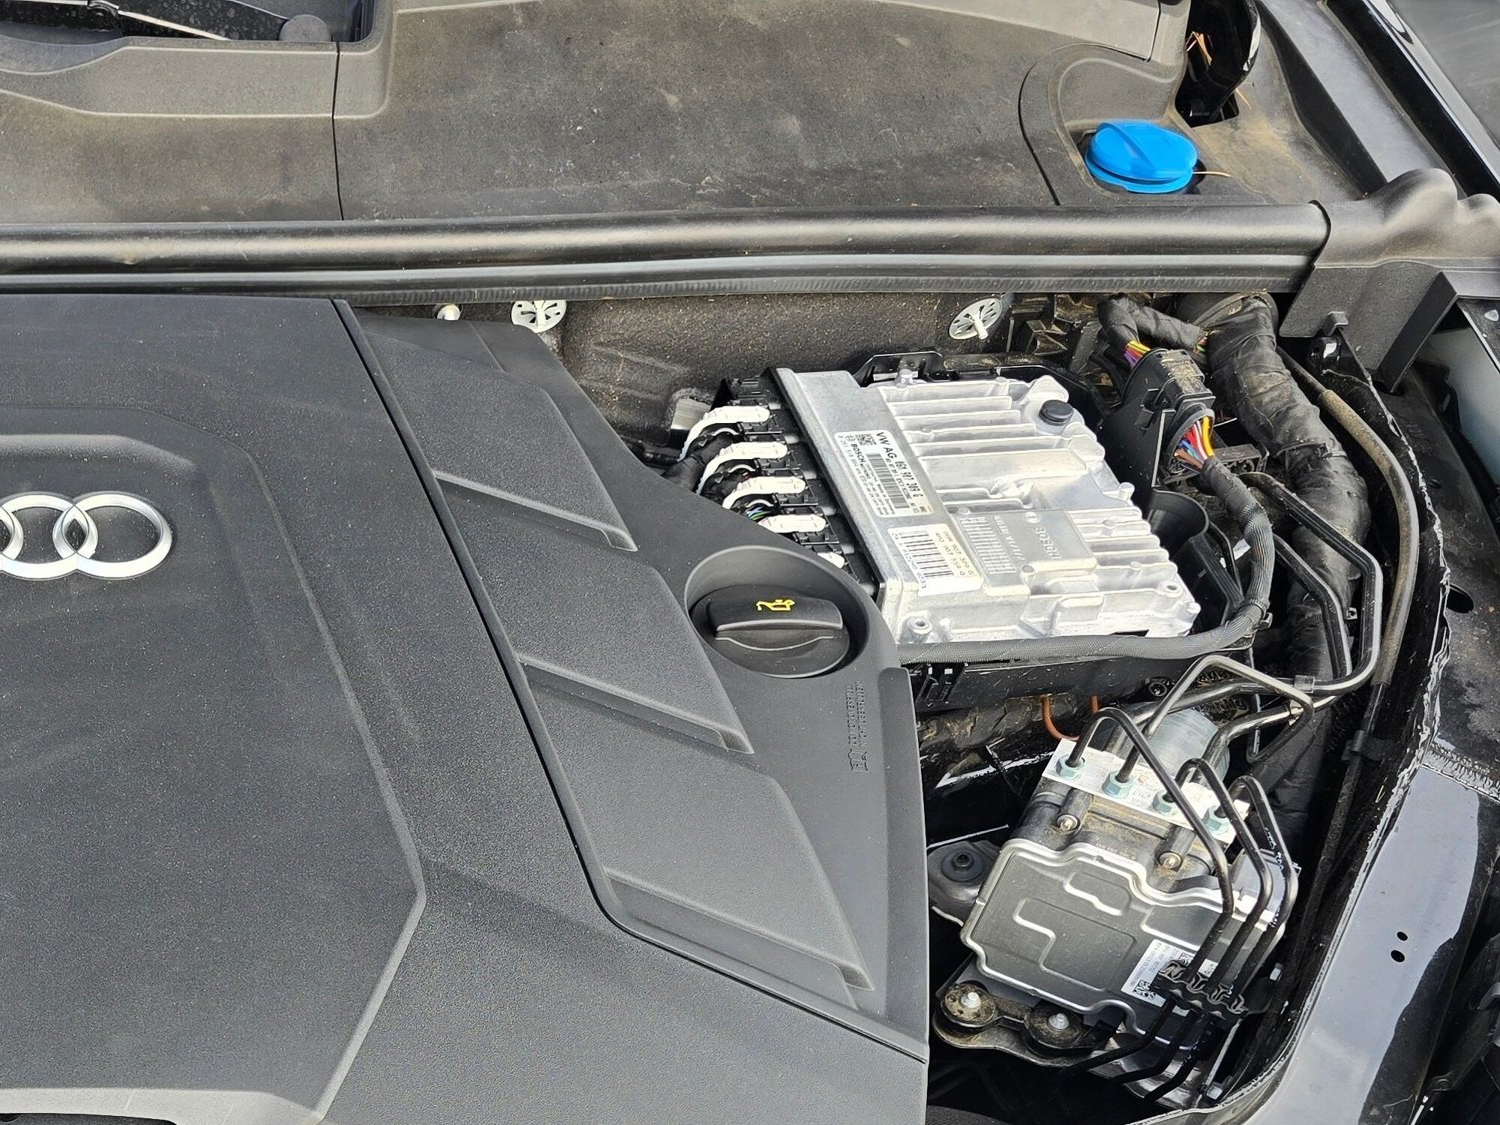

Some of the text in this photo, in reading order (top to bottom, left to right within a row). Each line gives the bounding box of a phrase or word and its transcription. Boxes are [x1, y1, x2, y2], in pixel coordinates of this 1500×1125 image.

[851, 444, 866, 462] BOSCH
[876, 432, 897, 459] VW AG
